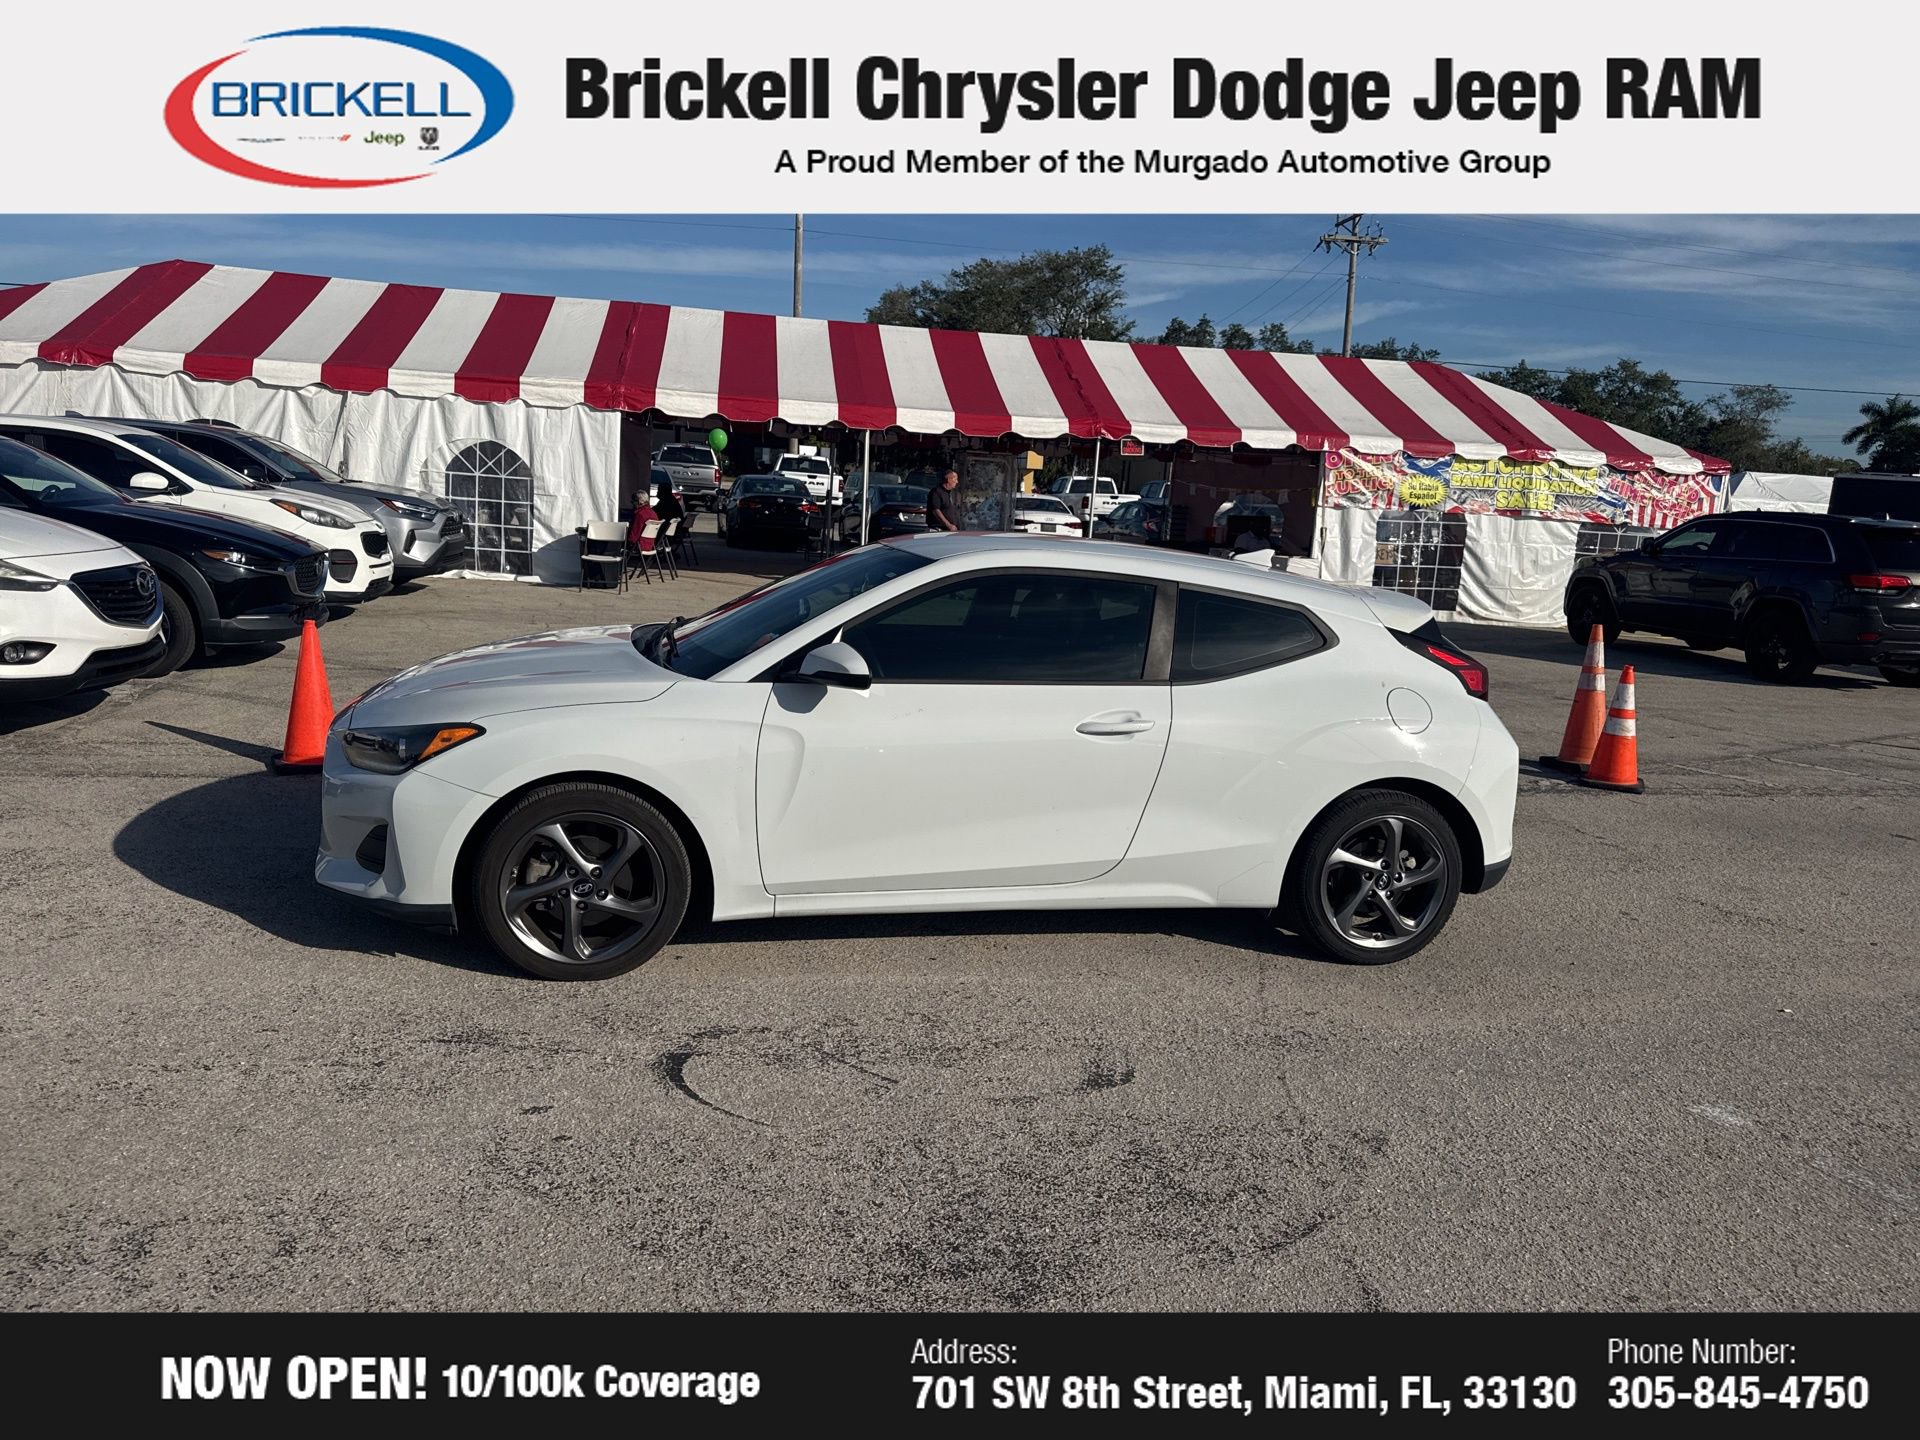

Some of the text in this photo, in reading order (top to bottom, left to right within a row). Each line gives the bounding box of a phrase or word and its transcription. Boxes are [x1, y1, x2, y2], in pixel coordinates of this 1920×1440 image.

[1336, 469, 1355, 480] TO
[1451, 474, 1598, 497] BANK LIQUIDATION
[1409, 491, 1437, 501] Español
[1496, 491, 1555, 510] SALE!
